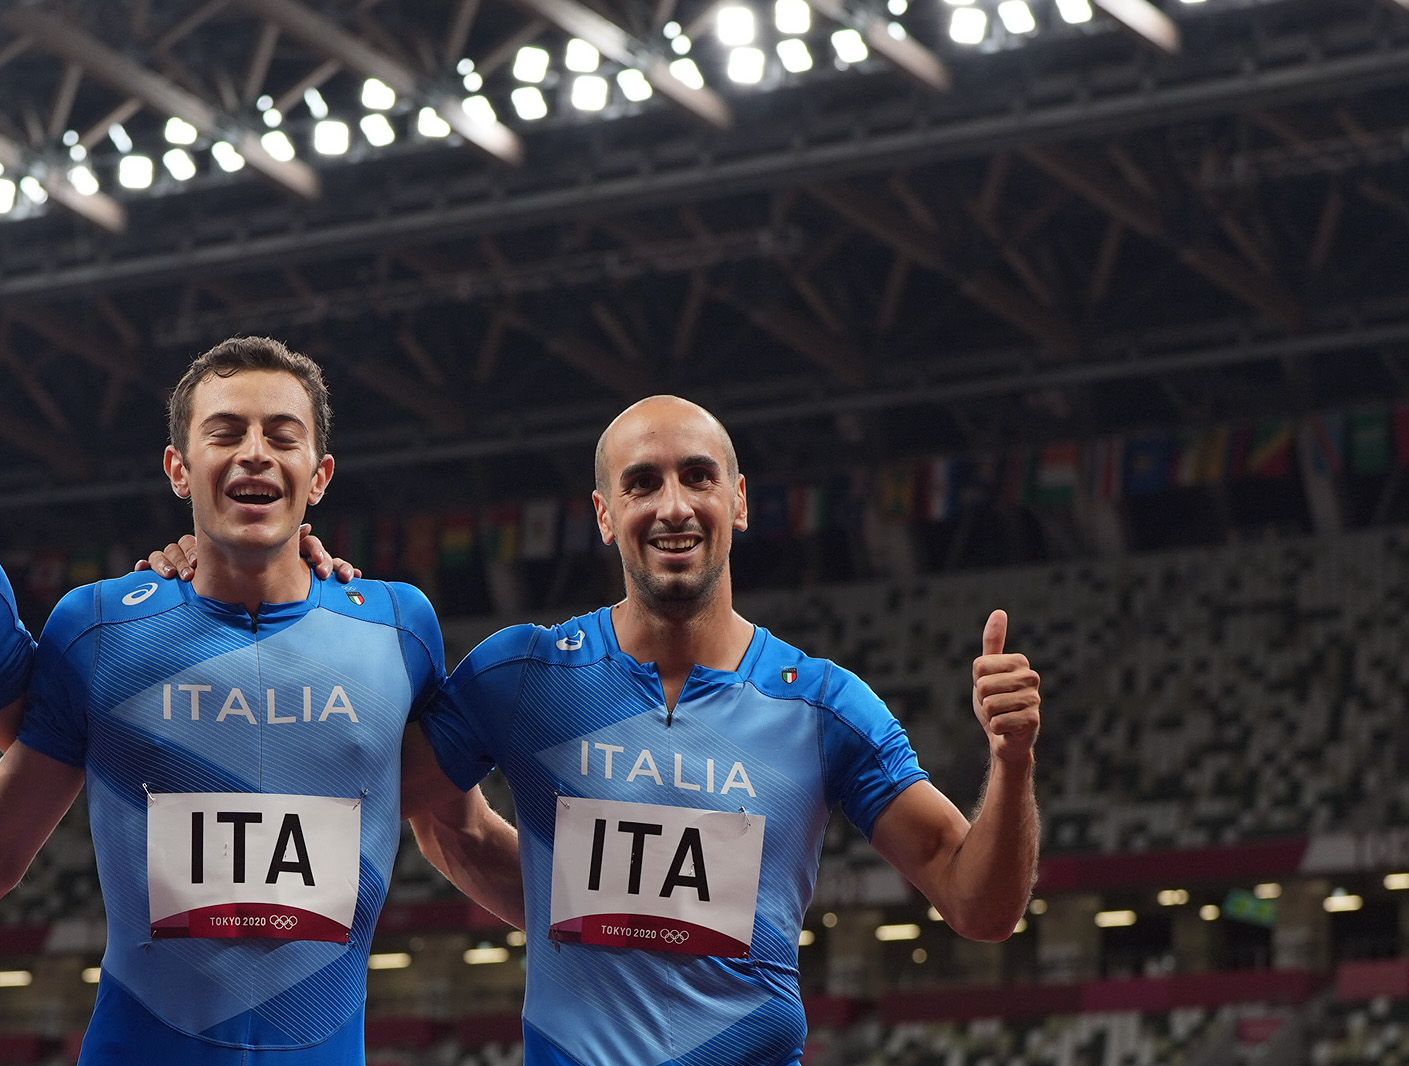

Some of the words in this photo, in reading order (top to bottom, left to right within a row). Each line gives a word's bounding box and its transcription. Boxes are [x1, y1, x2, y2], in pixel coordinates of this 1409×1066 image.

[161, 683, 359, 727] ITALIA
[579, 740, 757, 798] ITALIA
[189, 811, 317, 887] ITA
[586, 818, 712, 903] ITA
[209, 916, 241, 926] TOKYO
[242, 916, 267, 926] 2020
[600, 924, 632, 937] TOKYO
[633, 928, 657, 939] 2020
